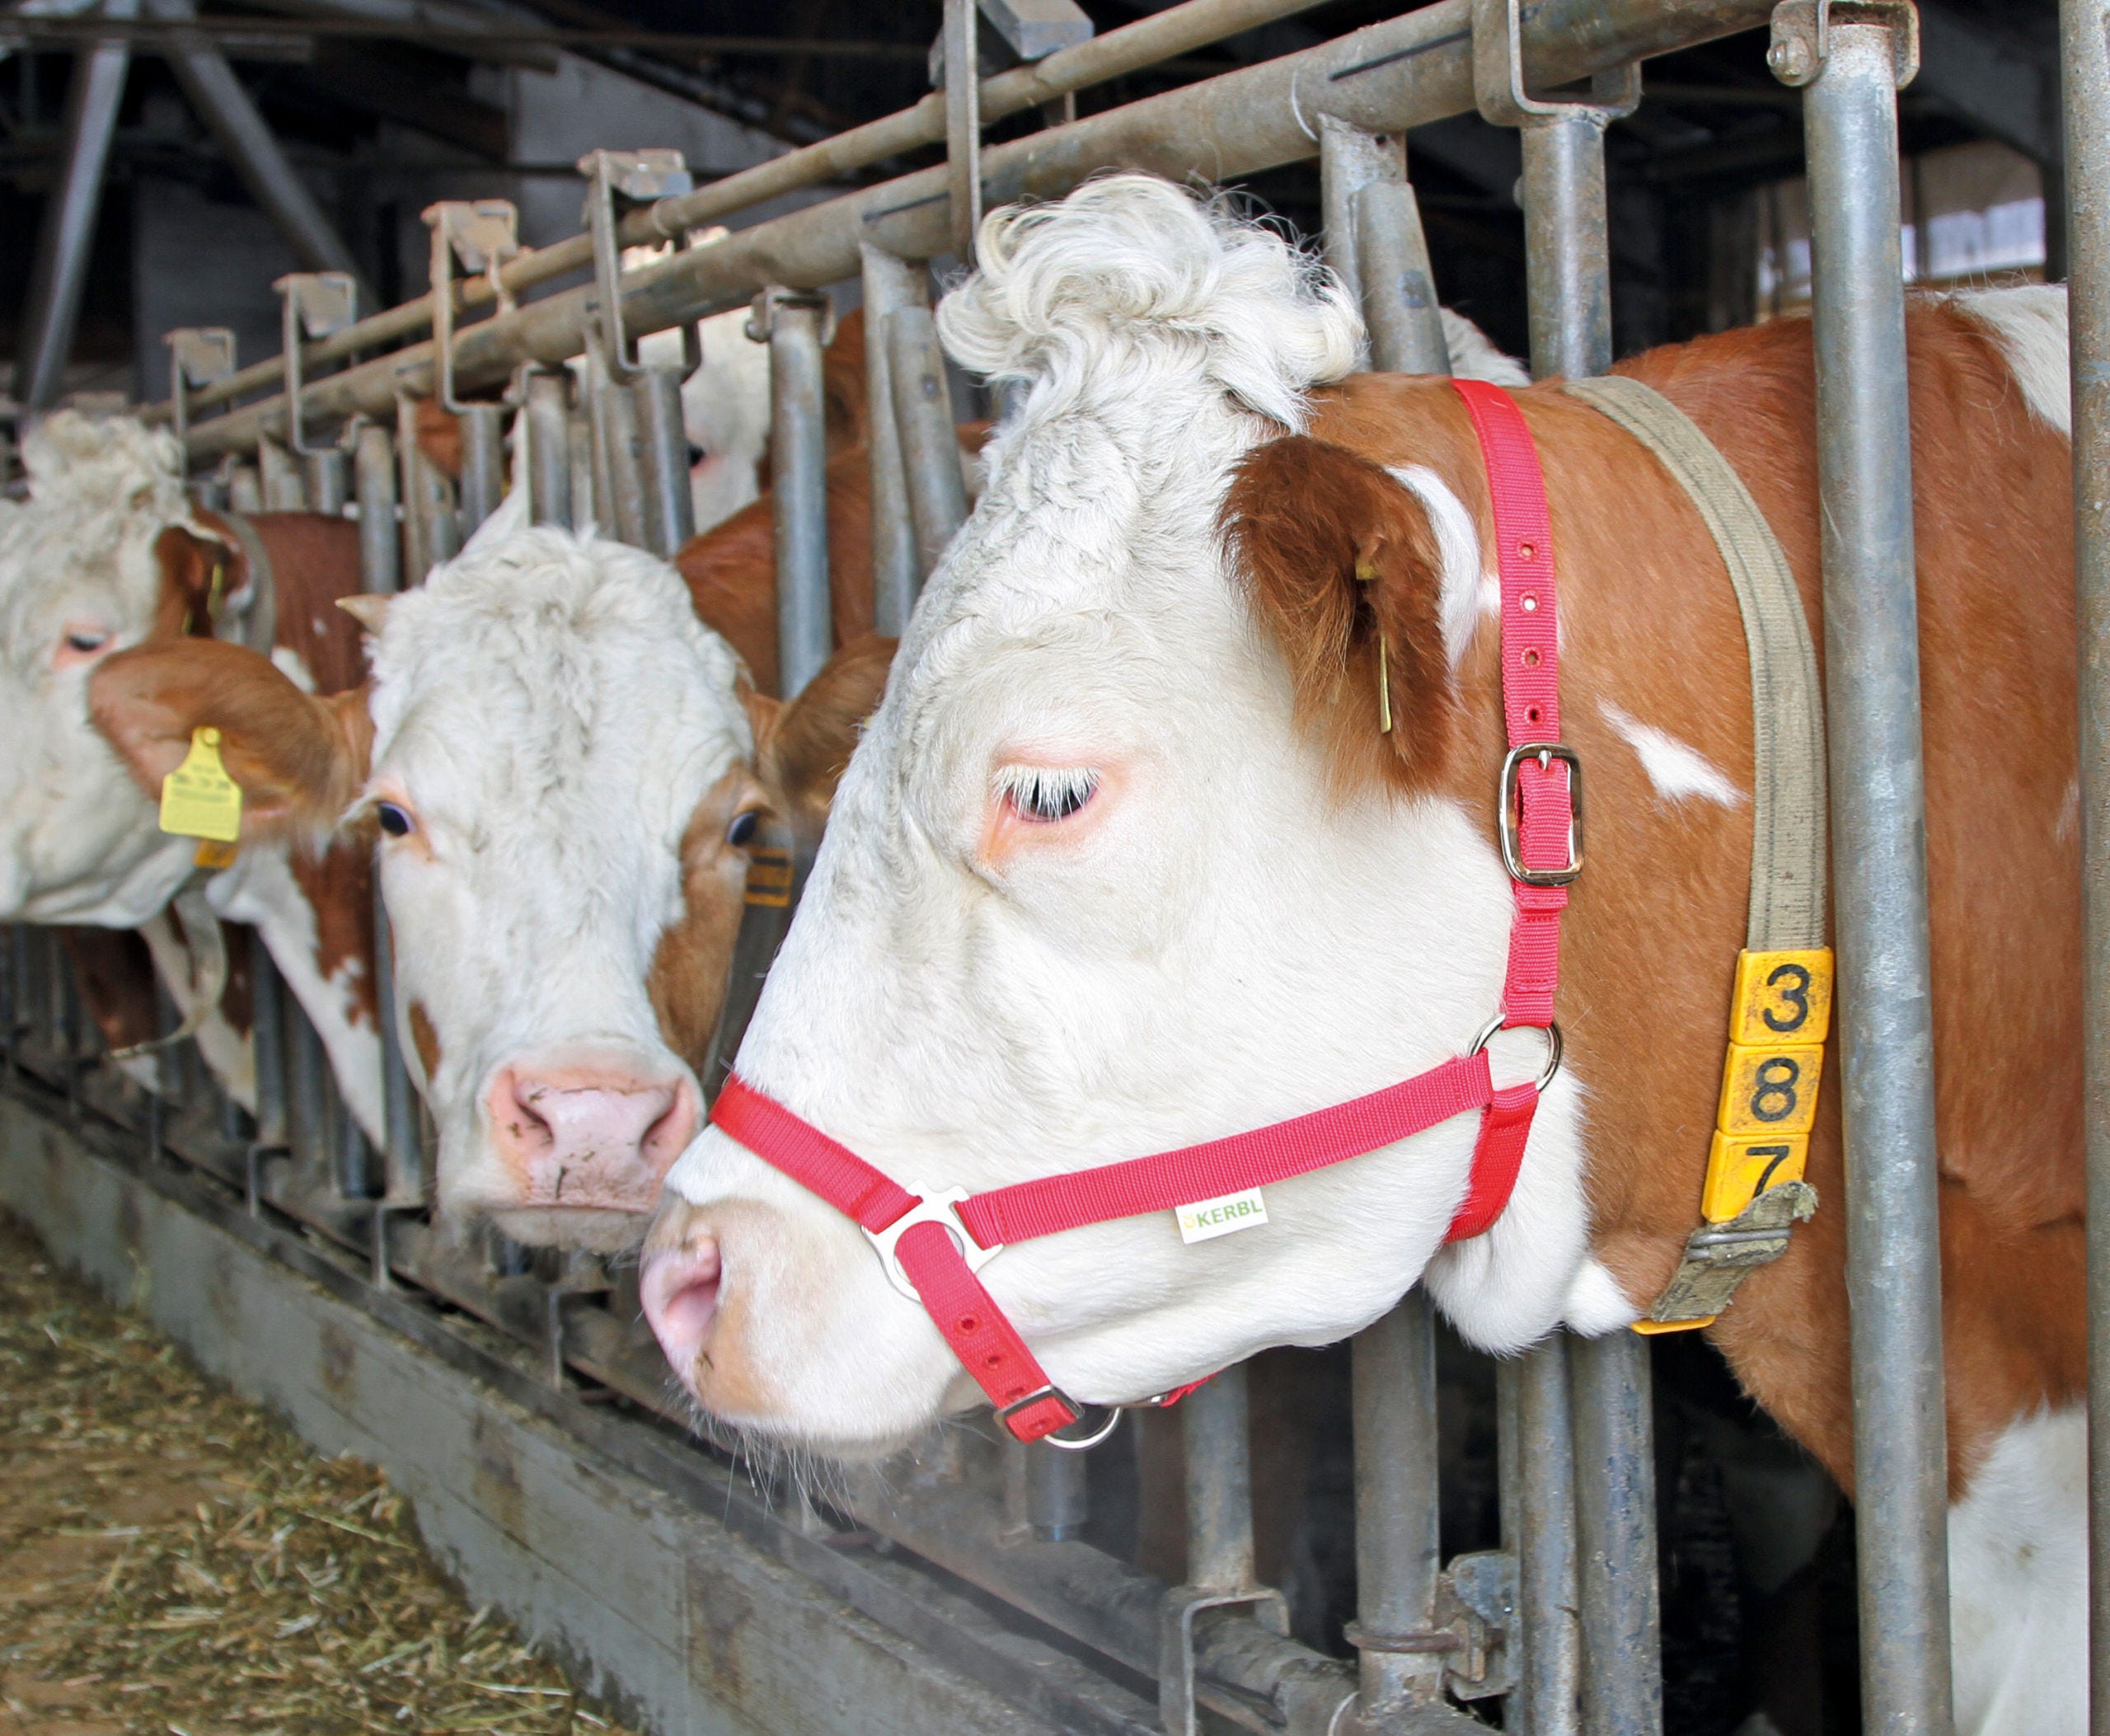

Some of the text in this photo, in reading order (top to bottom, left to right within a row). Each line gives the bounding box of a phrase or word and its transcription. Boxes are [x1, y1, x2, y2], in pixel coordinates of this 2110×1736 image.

[1763, 963, 1811, 1033] 3
[1750, 1056, 1800, 1123] 8
[1745, 1144, 1790, 1199] 7
[1195, 1199, 1264, 1228] KERBL
